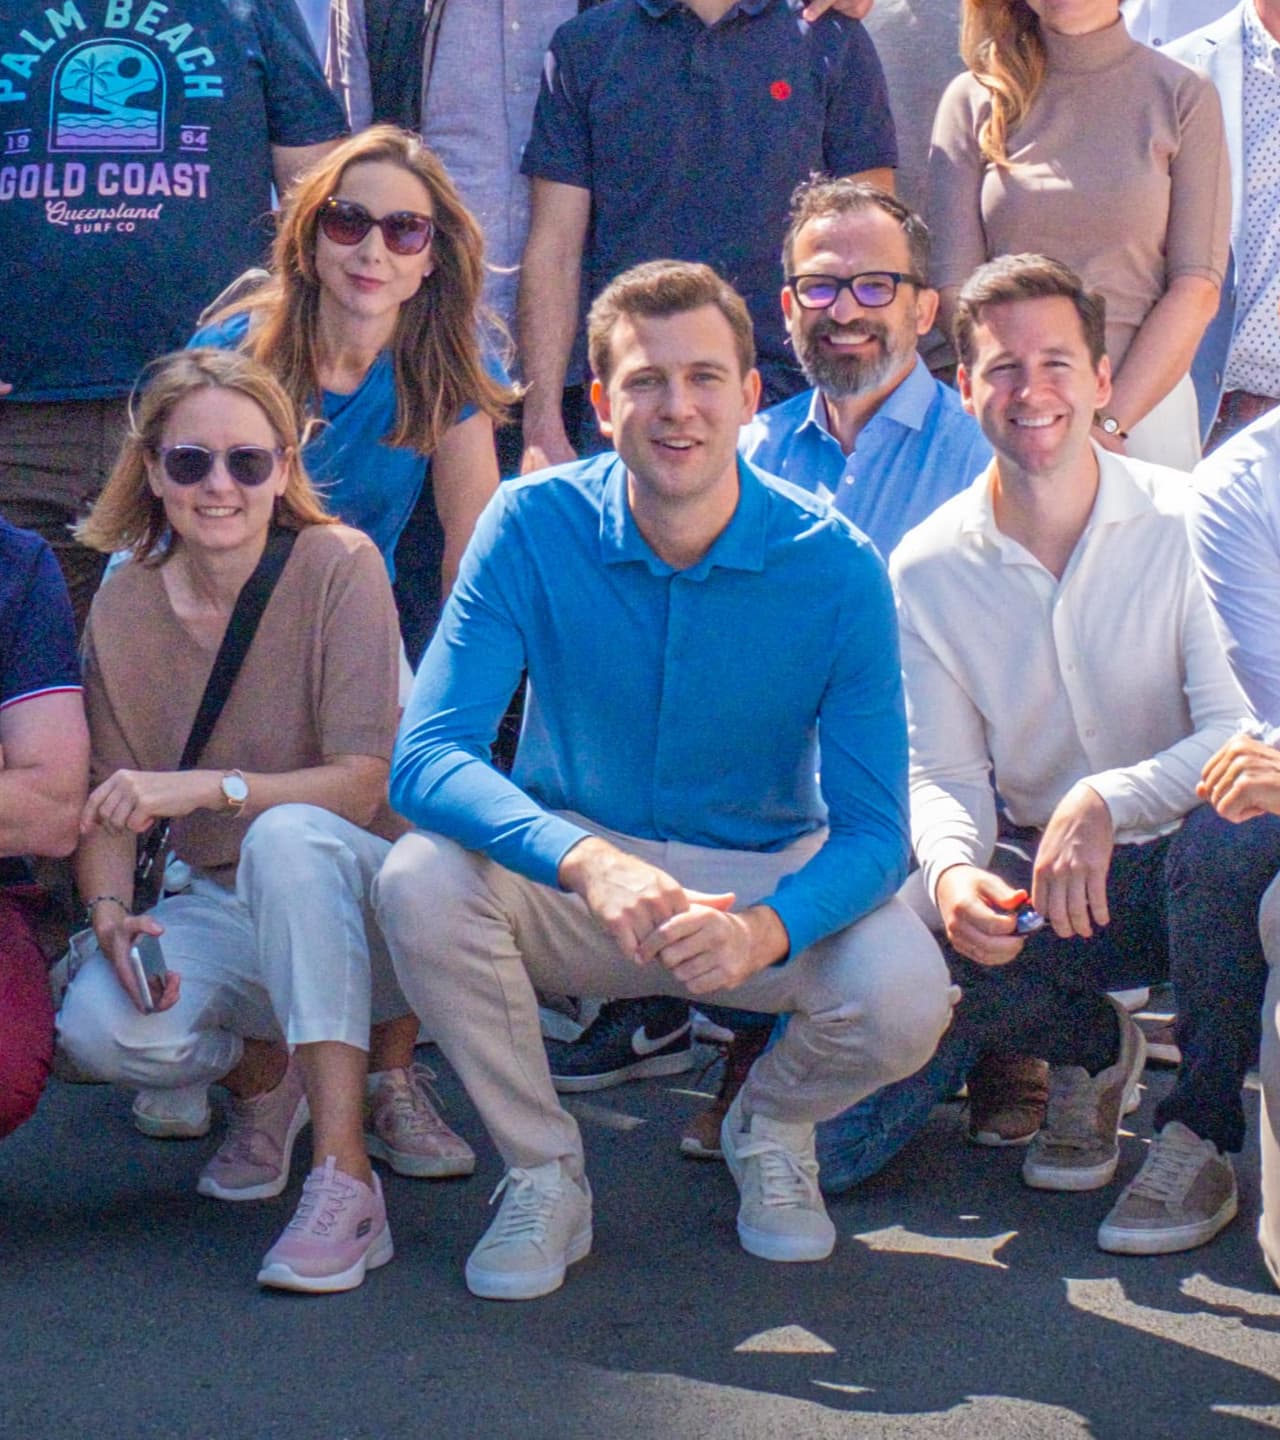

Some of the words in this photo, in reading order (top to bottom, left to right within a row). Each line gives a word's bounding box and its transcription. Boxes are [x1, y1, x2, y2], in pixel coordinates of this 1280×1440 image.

[8, 135, 29, 149] 19
[181, 131, 207, 145] 64
[98, 162, 210, 198] COAST
[45, 200, 163, 226] Queensland
[74, 222, 111, 234] SURF
[116, 221, 136, 233] CO
